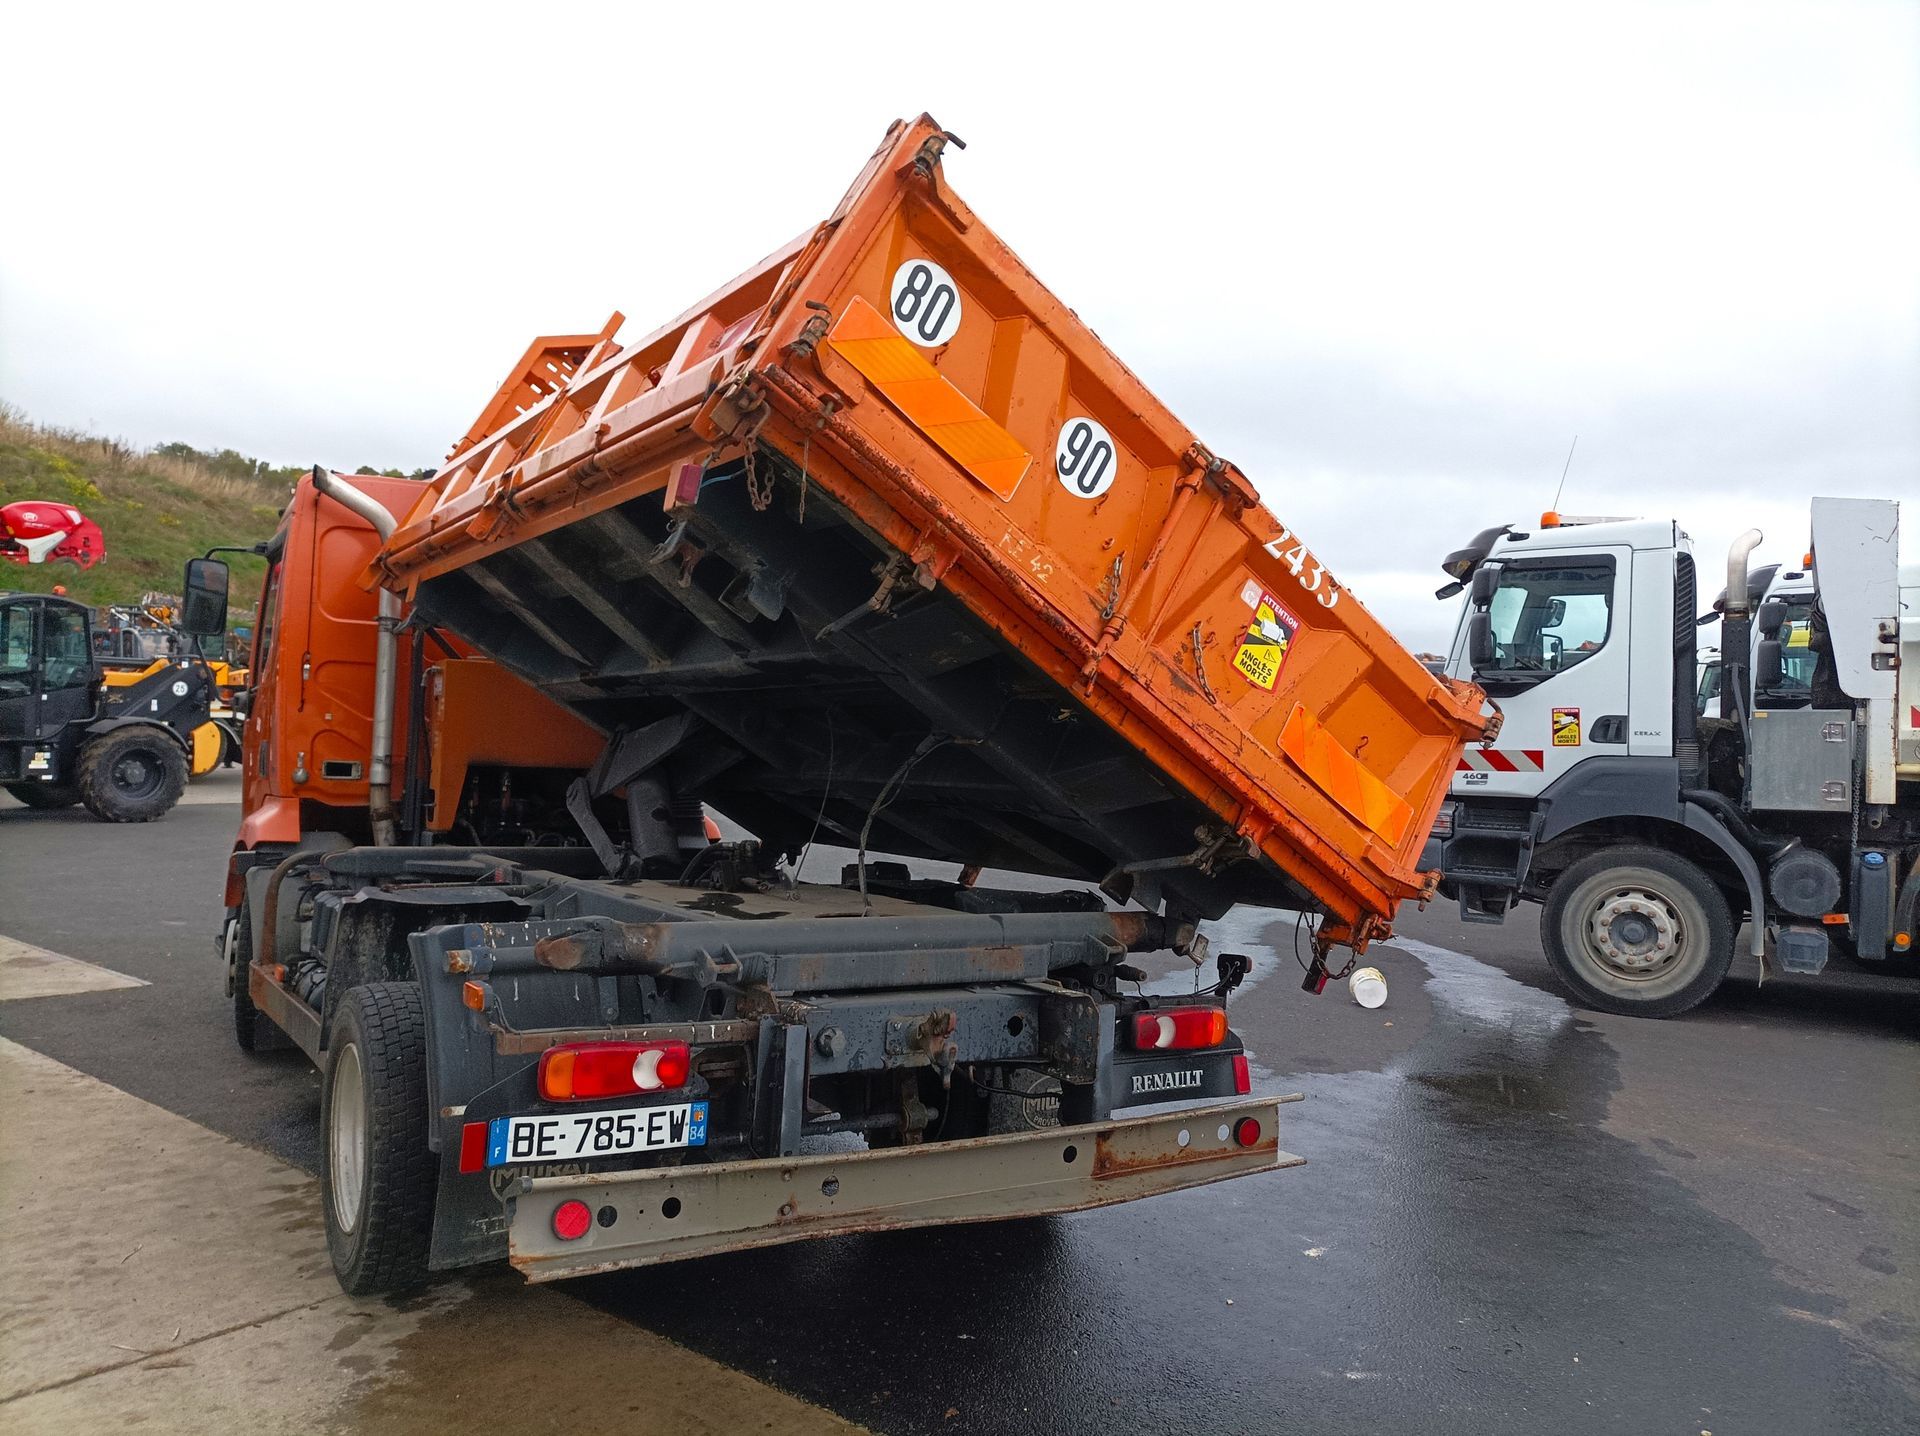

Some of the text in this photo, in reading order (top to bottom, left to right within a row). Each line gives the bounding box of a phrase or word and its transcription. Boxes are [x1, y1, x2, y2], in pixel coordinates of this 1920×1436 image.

[894, 263, 956, 341] 80
[1057, 421, 1112, 494] 90
[1263, 594, 1299, 630] ATTENTION
[1239, 658, 1269, 684] MORTS
[1241, 648, 1273, 677] ANGLES
[175, 684, 186, 694] 25
[1131, 1069, 1204, 1094] RENAULT
[494, 1108, 688, 1159] F BE-785-EW
[689, 1125, 705, 1140] 84
